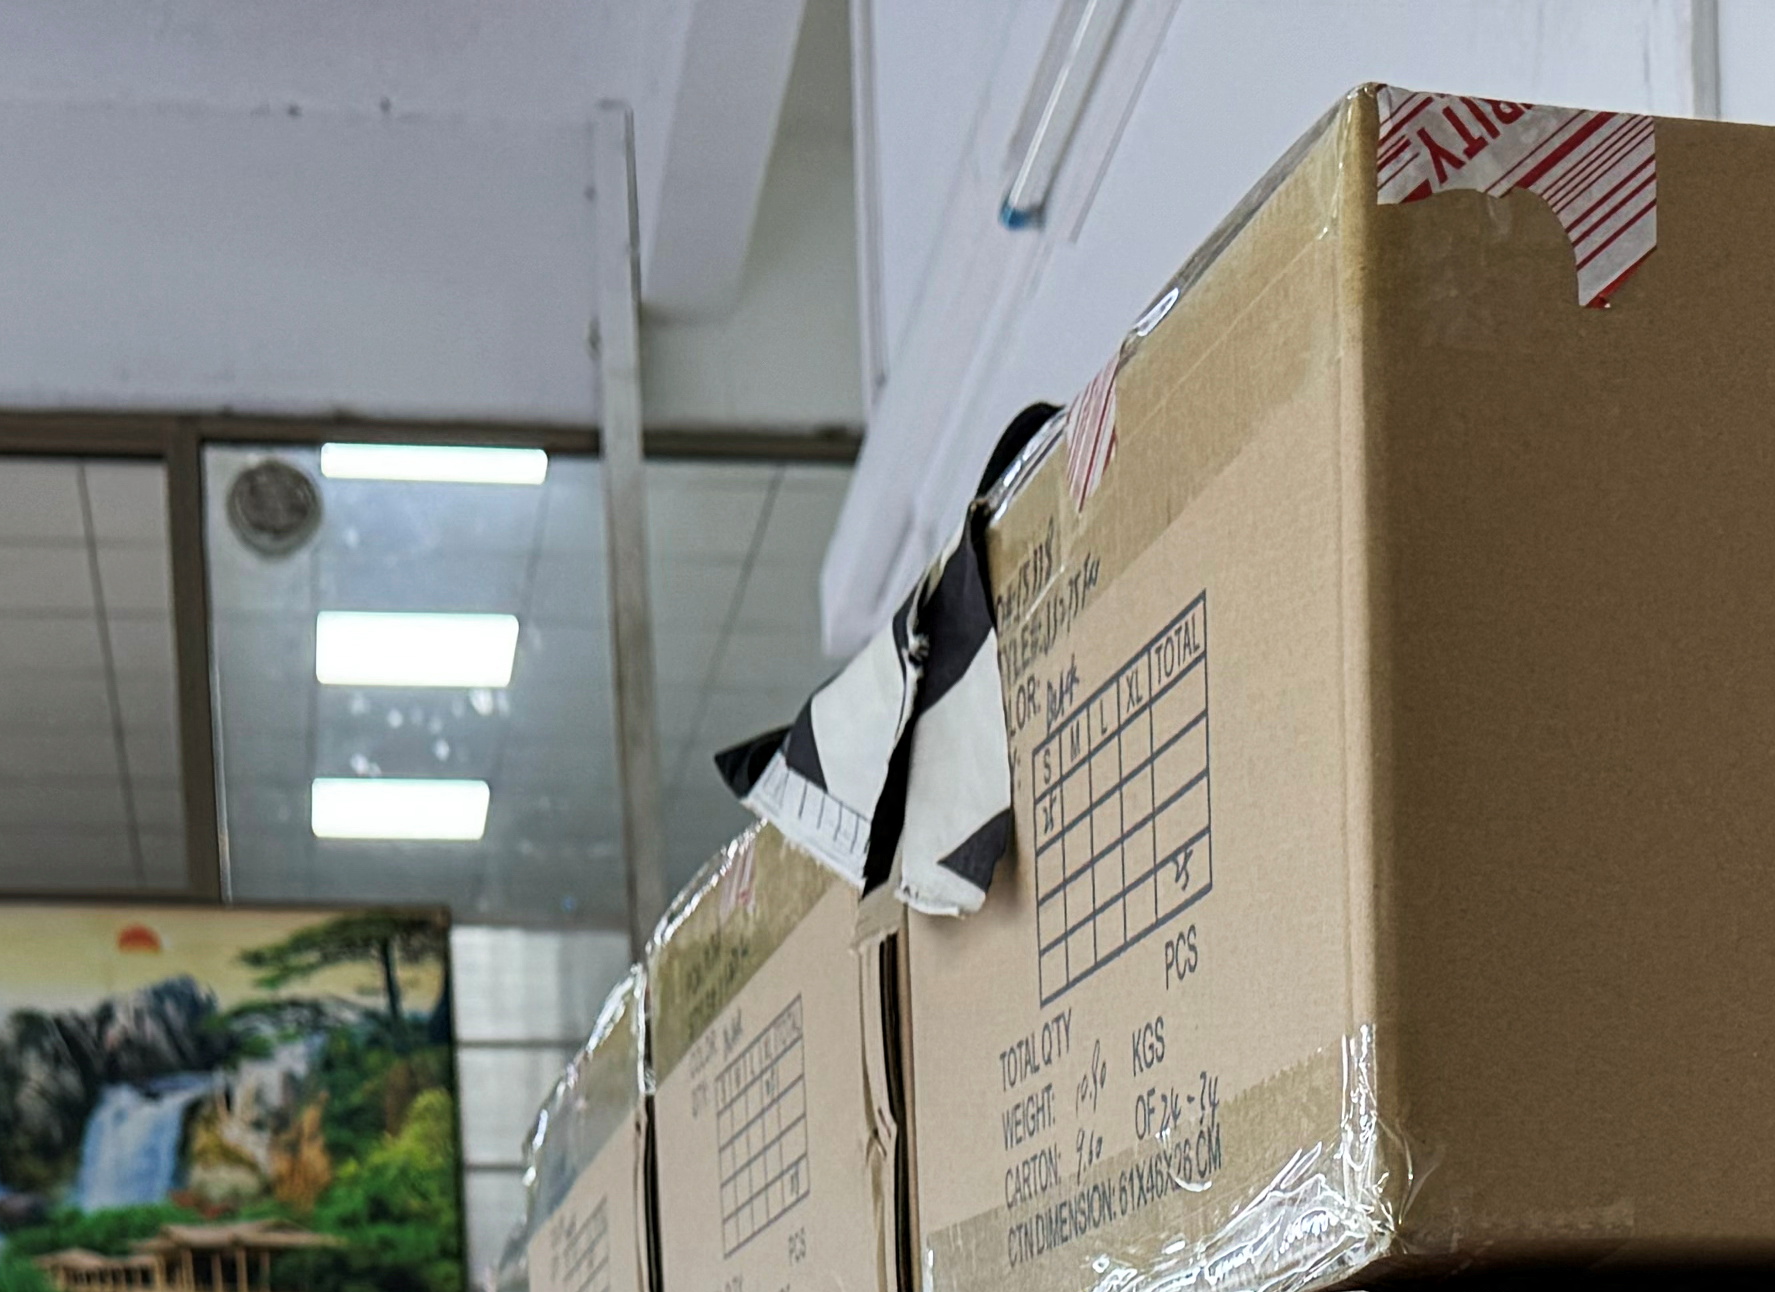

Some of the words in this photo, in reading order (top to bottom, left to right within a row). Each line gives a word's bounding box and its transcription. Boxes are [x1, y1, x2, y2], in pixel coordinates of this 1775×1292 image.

[1043, 749, 1052, 785] S
[1070, 721, 1081, 762] M
[1100, 699, 1108, 736] L
[1125, 669, 1143, 713] XL
[1155, 613, 1200, 686] TOTAL
[1165, 924, 1198, 990] PCS
[1000, 1031, 1040, 1092] TOTAL
[1002, 1083, 1056, 1151] WEIGHT:
[1132, 1016, 1166, 1077] KGS
[1004, 1144, 1062, 1210] CARTON:
[1135, 1087, 1156, 1140] OF
[1008, 1221, 1035, 1269] CTN
[1196, 1122, 1222, 1180] CM
